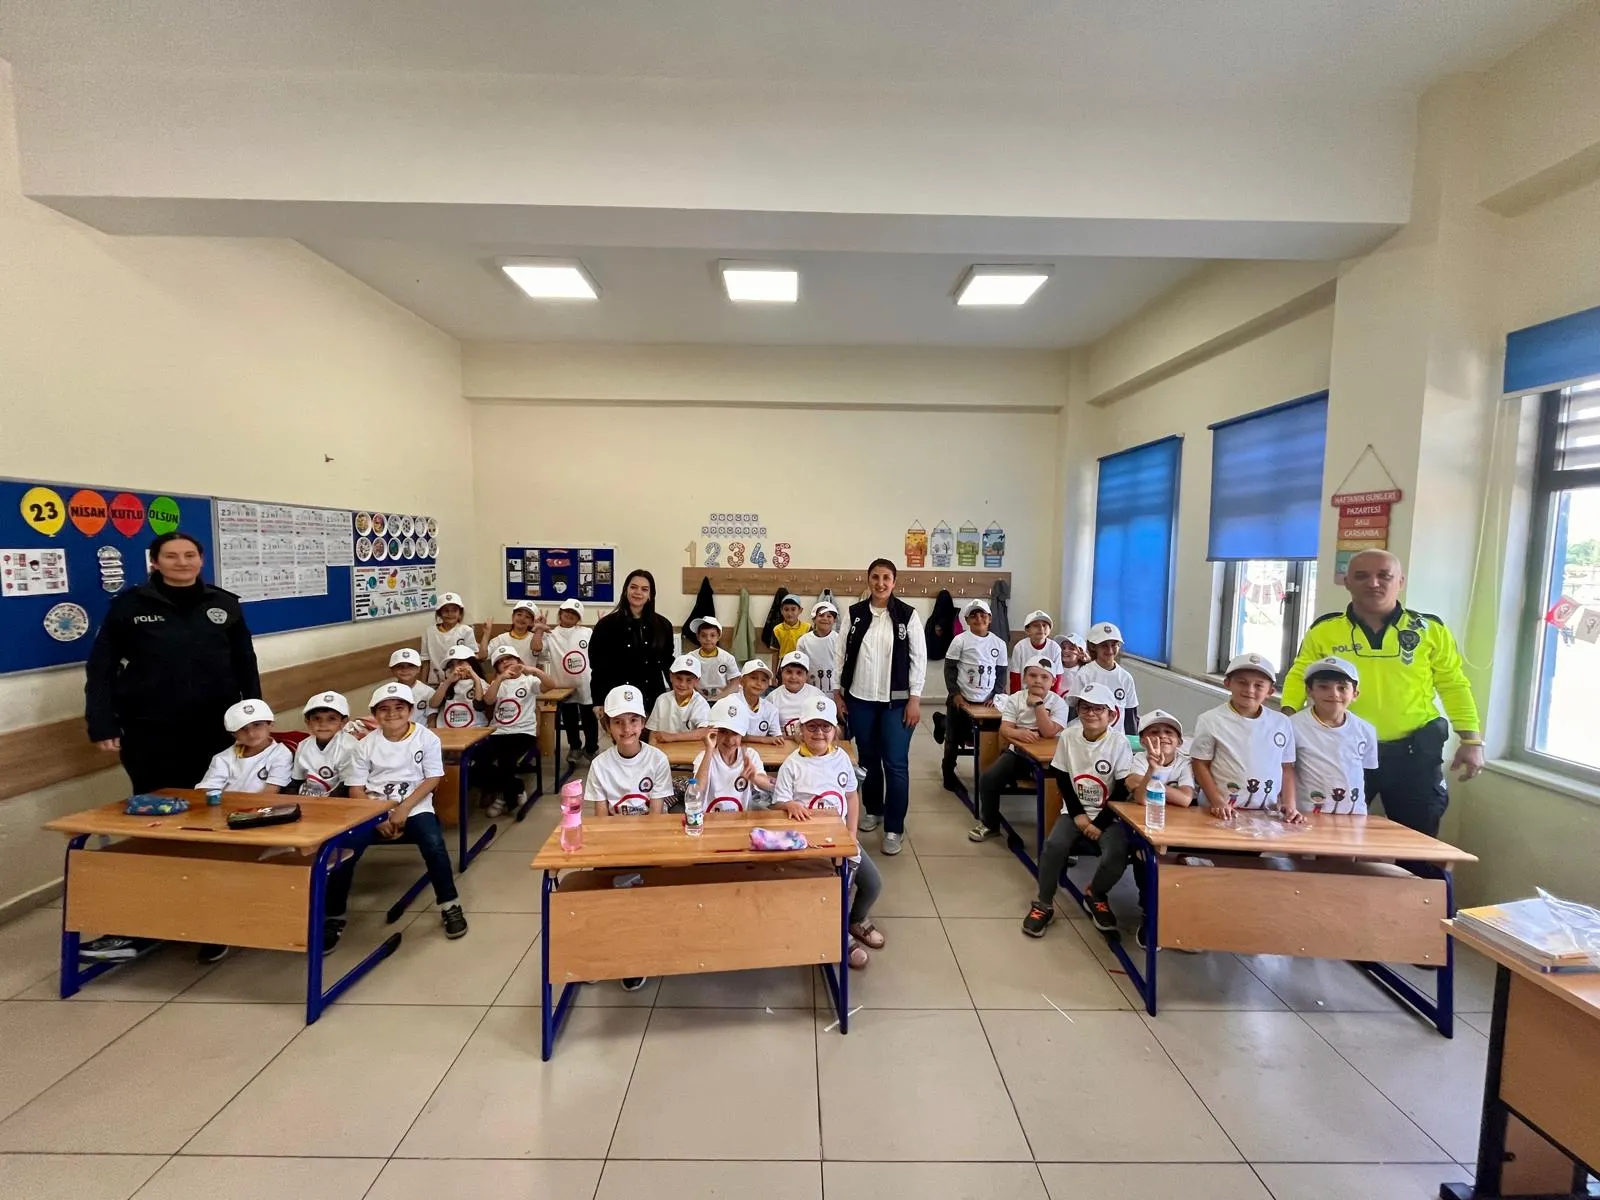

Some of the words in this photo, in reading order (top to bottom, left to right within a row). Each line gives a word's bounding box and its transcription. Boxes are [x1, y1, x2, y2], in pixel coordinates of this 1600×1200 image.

[30, 501, 58, 522] 23
[71, 504, 106, 518] NİSAN
[111, 508, 144, 520] KUTLU
[149, 509, 179, 524] OLSUN
[684, 541, 697, 567] 1
[704, 541, 721, 568] 2
[727, 542, 746, 568] 3
[750, 542, 767, 568] 4
[772, 543, 791, 568] 5
